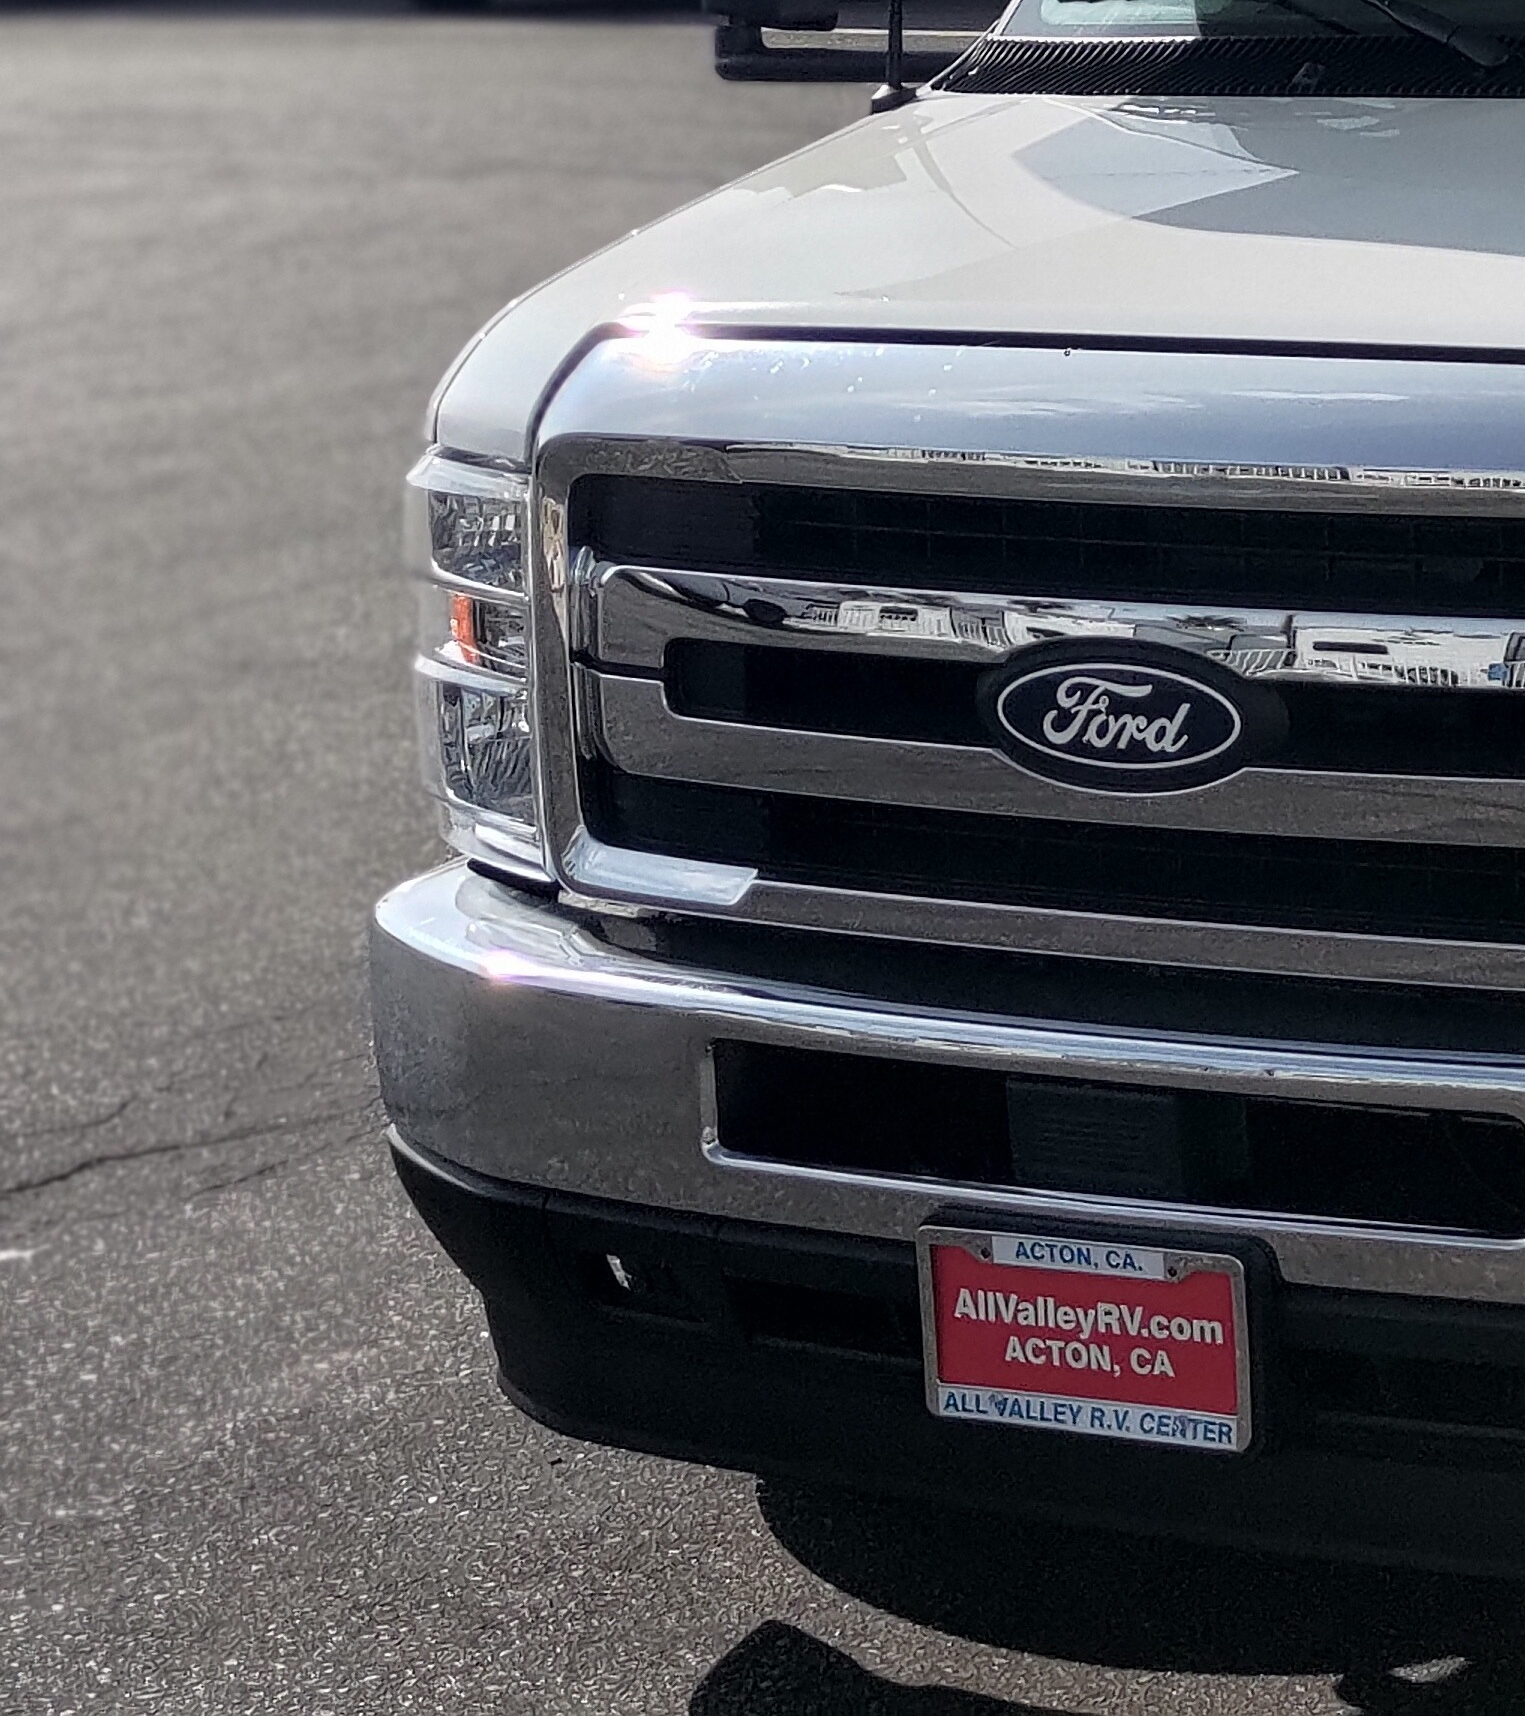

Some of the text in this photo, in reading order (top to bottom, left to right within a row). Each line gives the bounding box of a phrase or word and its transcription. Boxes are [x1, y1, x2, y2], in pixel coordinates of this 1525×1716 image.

[1043, 676, 1191, 753] Ford
[1014, 1241, 1143, 1272] ACTON, CA.
[953, 1288, 1224, 1345] AllValleyRV.com
[1004, 1336, 1176, 1378] ACTON, CA
[944, 1391, 1233, 1444] ALL VALLEY R.V. CENTER
